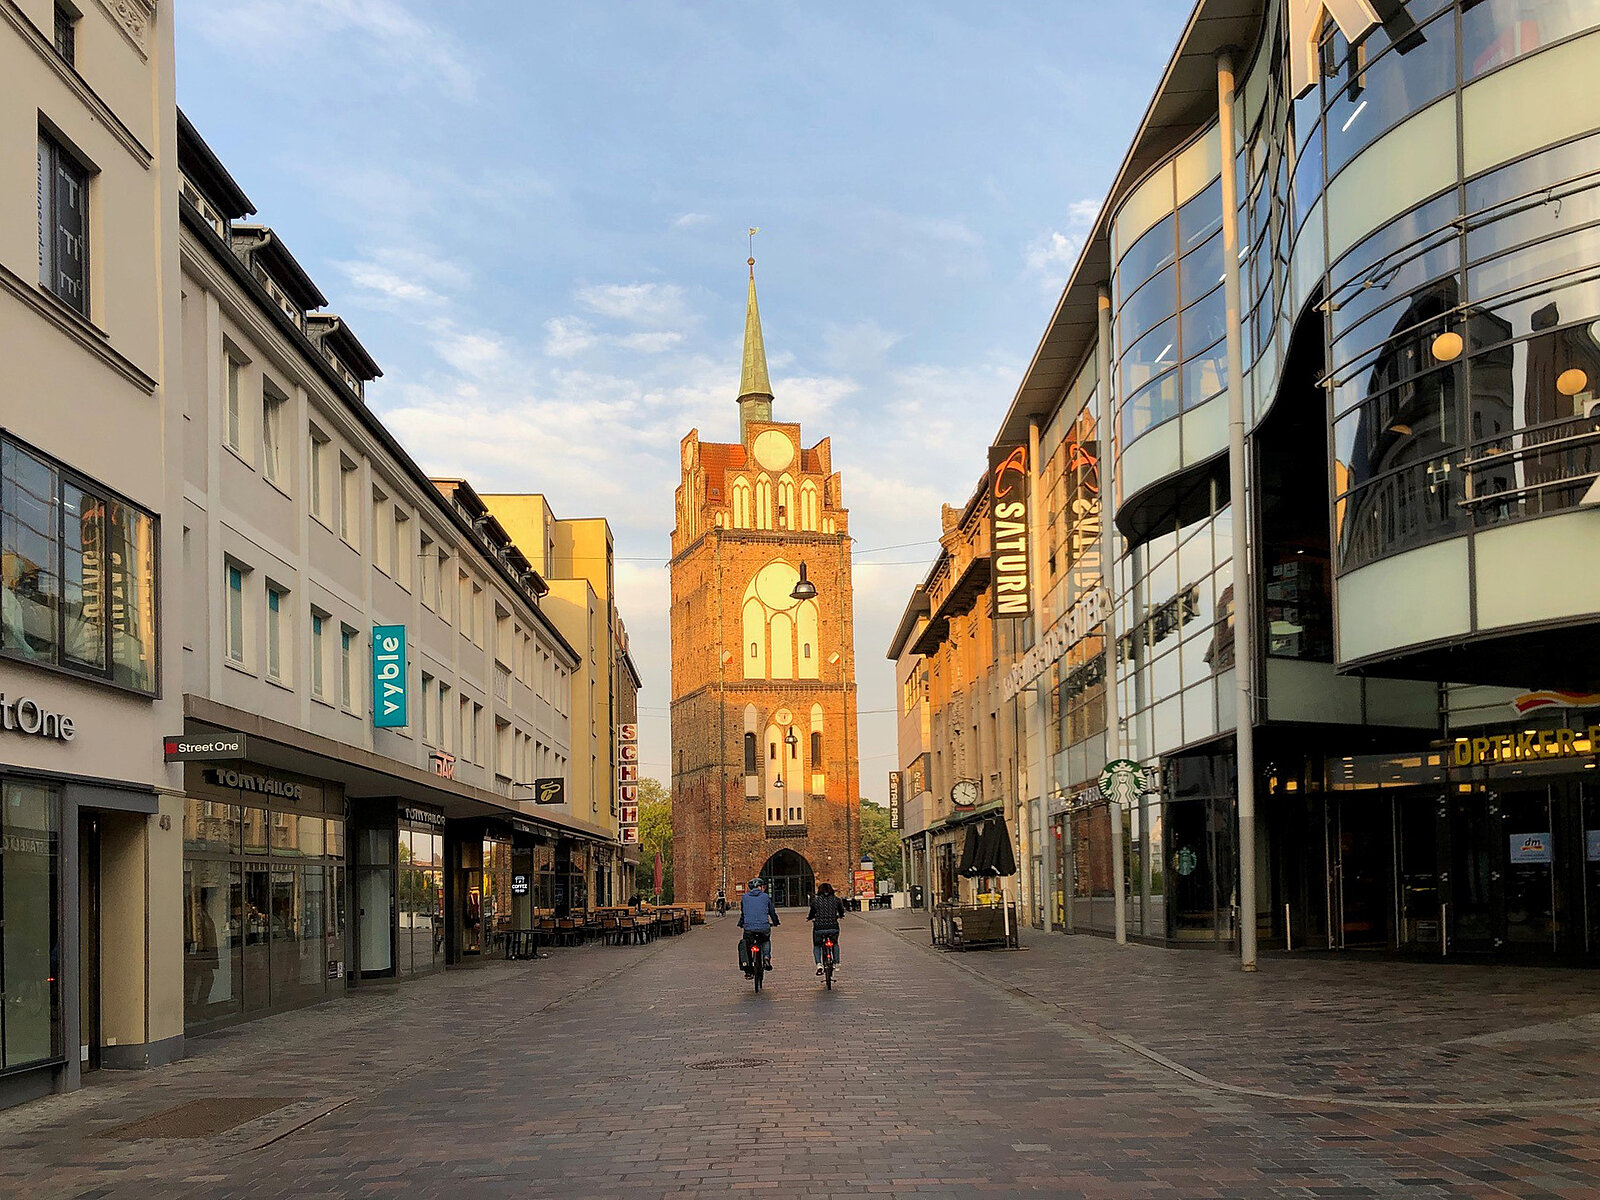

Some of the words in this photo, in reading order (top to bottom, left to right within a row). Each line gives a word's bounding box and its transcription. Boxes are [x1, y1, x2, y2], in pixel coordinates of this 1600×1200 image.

[994, 502, 1028, 614] SATURN
[377, 636, 404, 716] vyble
[15, 696, 76, 742] One
[178, 742, 214, 754] Street
[214, 741, 239, 752] One
[1454, 727, 1576, 768] OPTIKER
[216, 769, 256, 791] TOM
[255, 776, 303, 799] TAILOR
[621, 725, 637, 843] SCHUHE
[890, 808, 899, 828] RAW
[1524, 836, 1541, 847] dm
